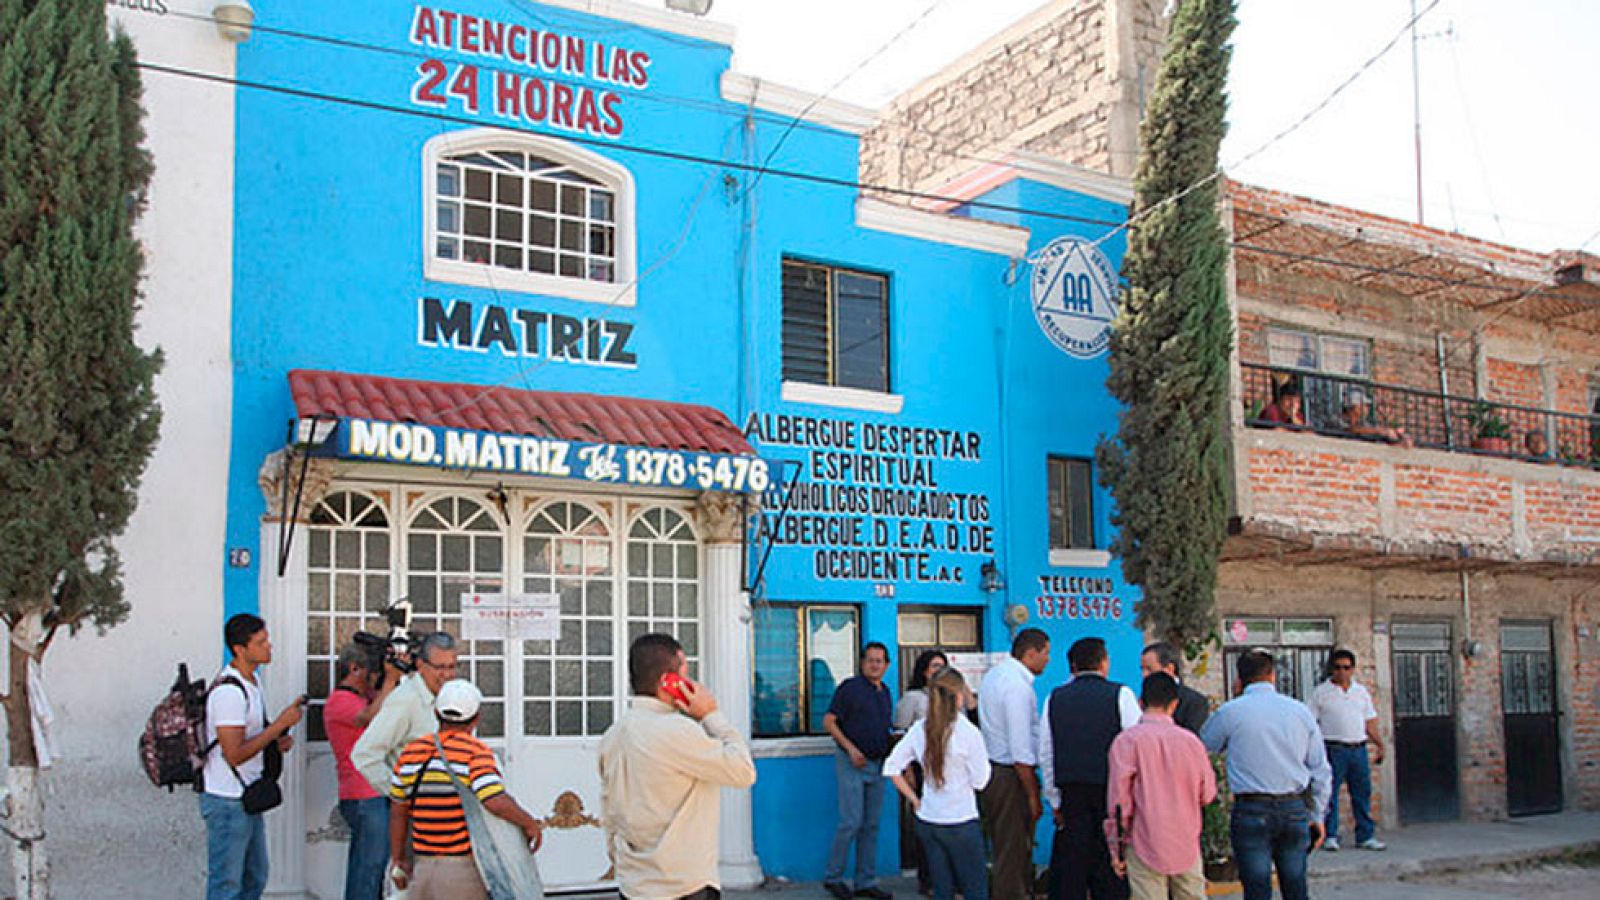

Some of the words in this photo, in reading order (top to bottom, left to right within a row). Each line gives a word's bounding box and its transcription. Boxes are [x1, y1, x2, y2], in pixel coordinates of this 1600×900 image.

[410, 5, 586, 76] ATENCION
[592, 42, 651, 89] LAS
[410, 58, 480, 114] 24
[493, 70, 624, 138] HORAS
[1063, 272, 1092, 313] AA
[418, 297, 638, 369] MATRIZ
[350, 418, 442, 465] MOD.
[445, 430, 570, 476] MATRIZ
[743, 411, 856, 450] ALBERGUE
[862, 422, 980, 462] DESPERTAR
[811, 450, 938, 489] ESPIRITUAL
[1036, 596, 1122, 620] 13785476
[1038, 575, 1114, 595] TELEFONO
